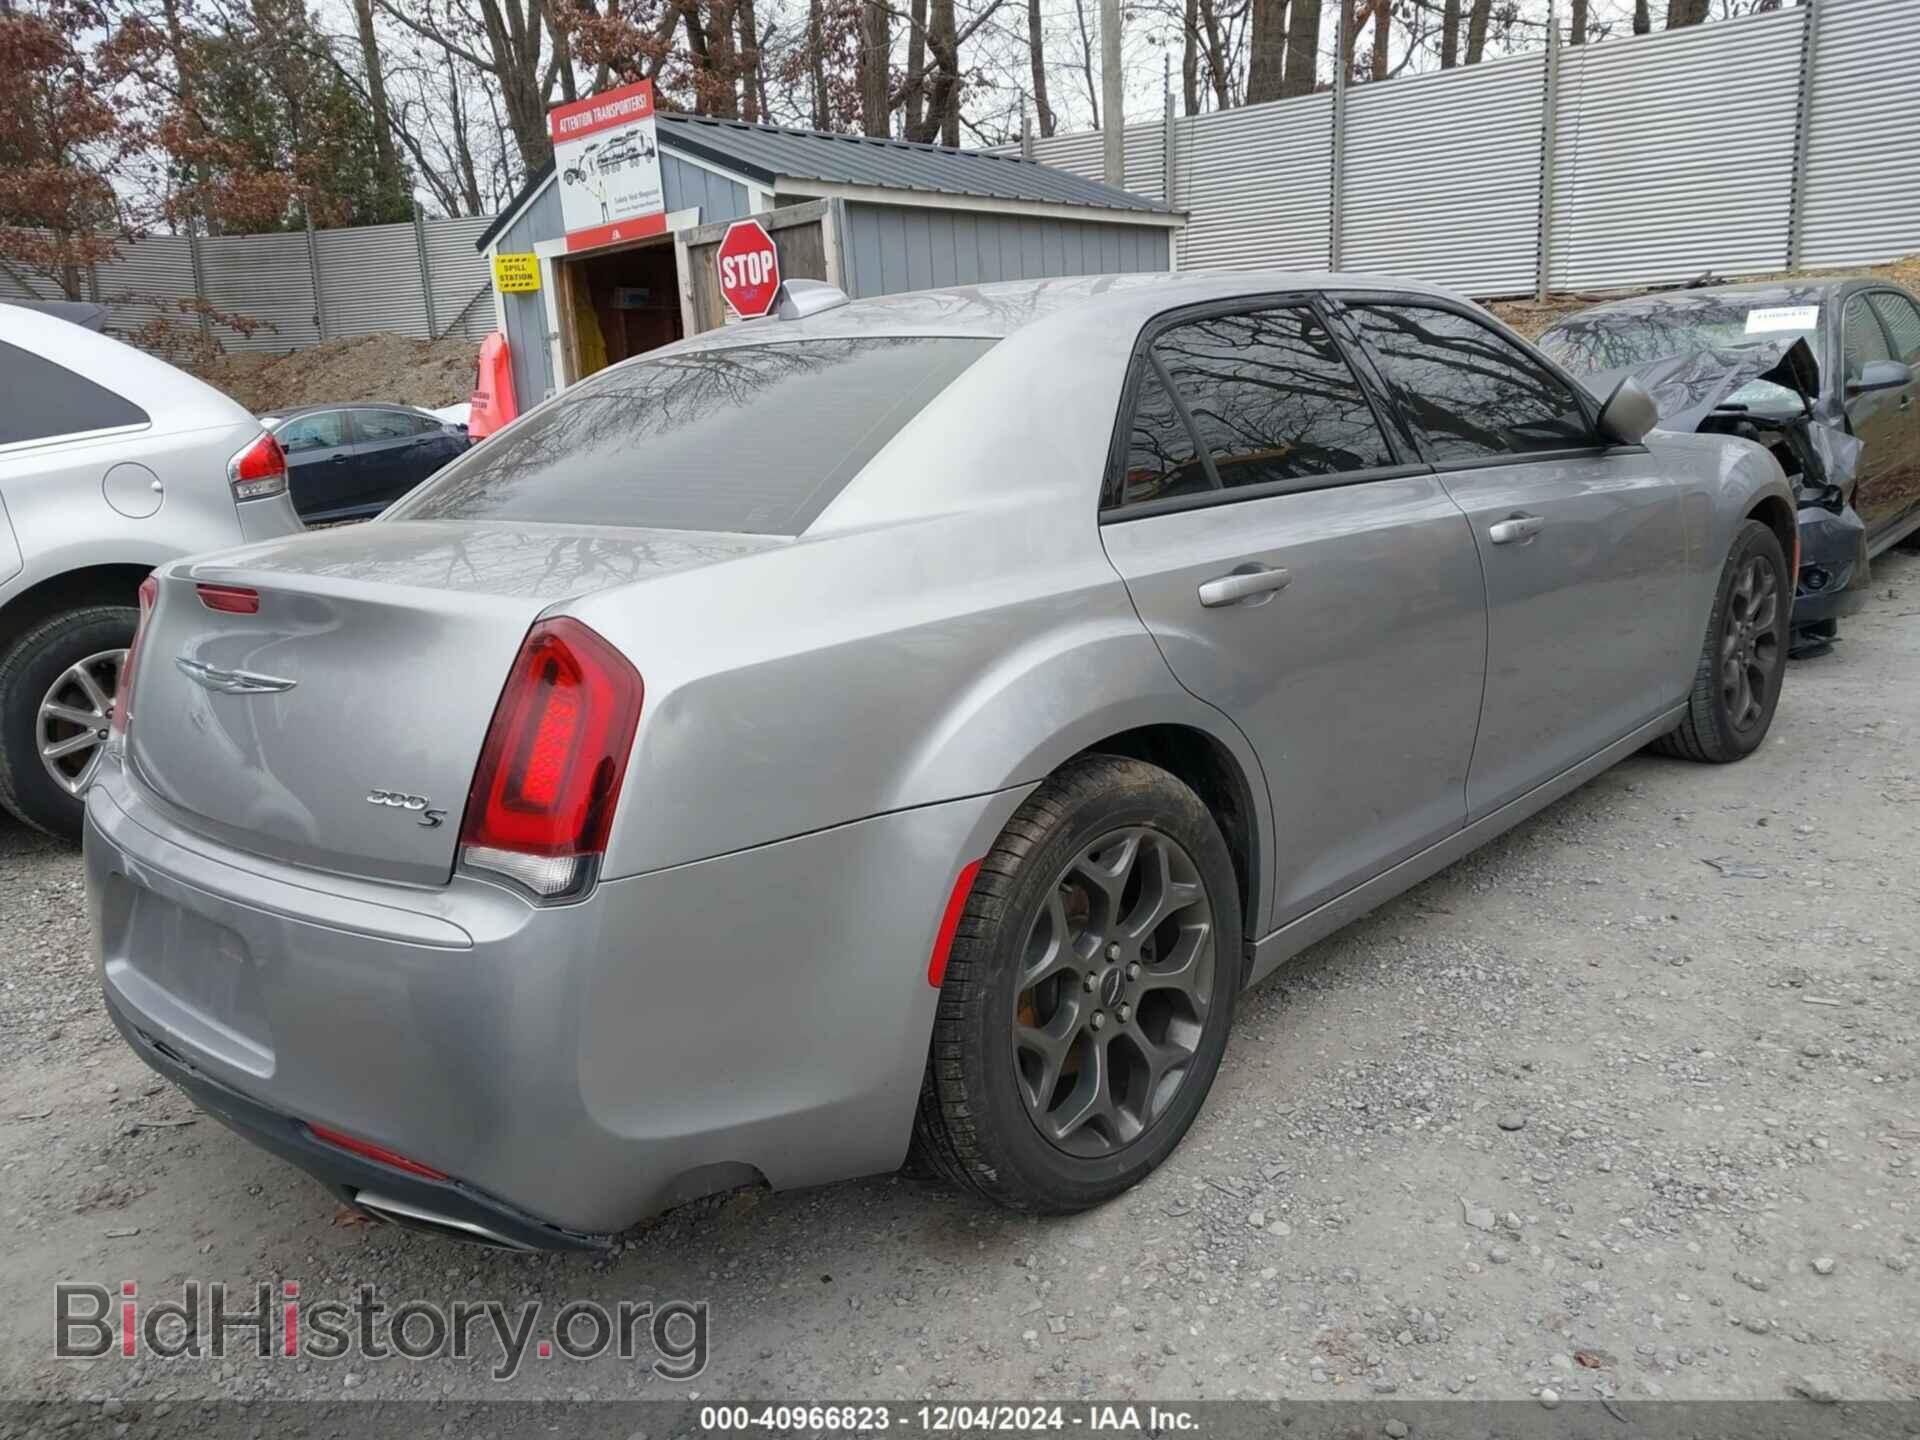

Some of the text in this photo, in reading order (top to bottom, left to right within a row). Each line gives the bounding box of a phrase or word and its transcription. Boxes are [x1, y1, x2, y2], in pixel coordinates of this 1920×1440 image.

[559, 110, 593, 133] ATTENTION
[499, 272, 533, 282] STATION
[503, 264, 527, 273] SPILL
[722, 249, 774, 289] STOP
[366, 788, 429, 811] 300
[417, 808, 448, 829] S
